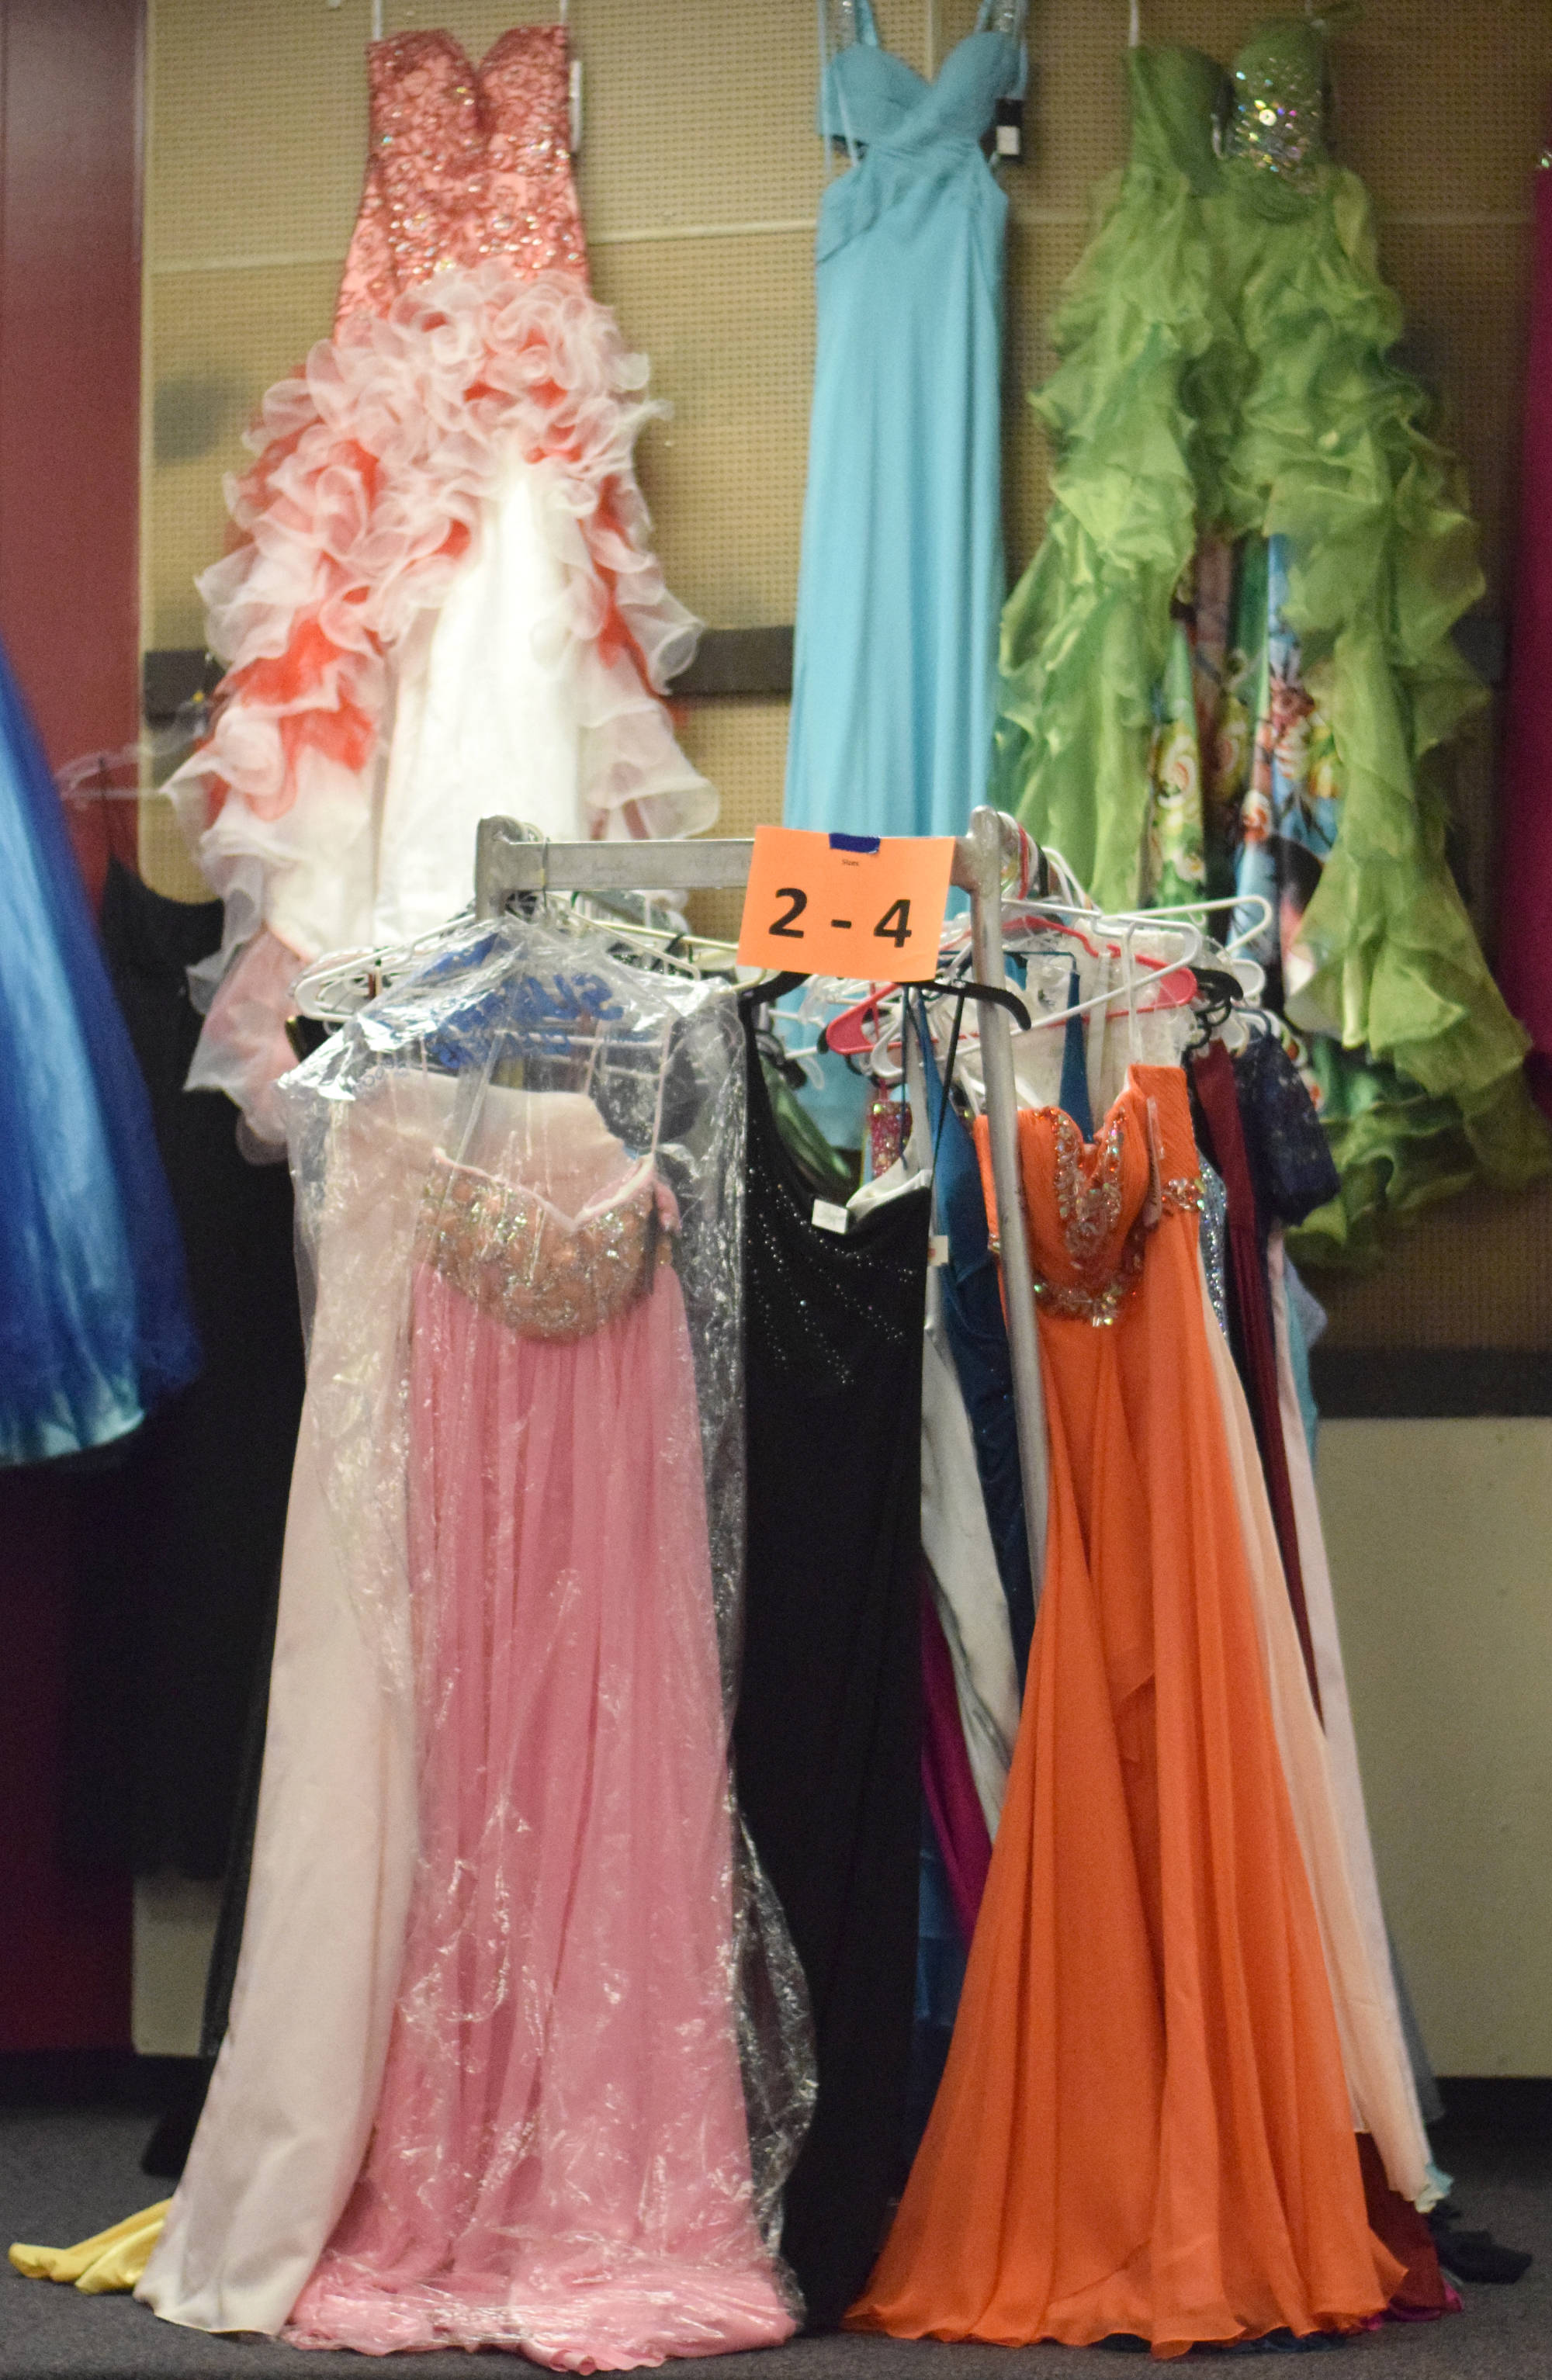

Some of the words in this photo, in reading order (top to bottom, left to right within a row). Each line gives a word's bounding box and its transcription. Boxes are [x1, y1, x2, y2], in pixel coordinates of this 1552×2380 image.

[768, 887, 808, 939] 2
[830, 919, 852, 929] -
[873, 899, 913, 948] 4
